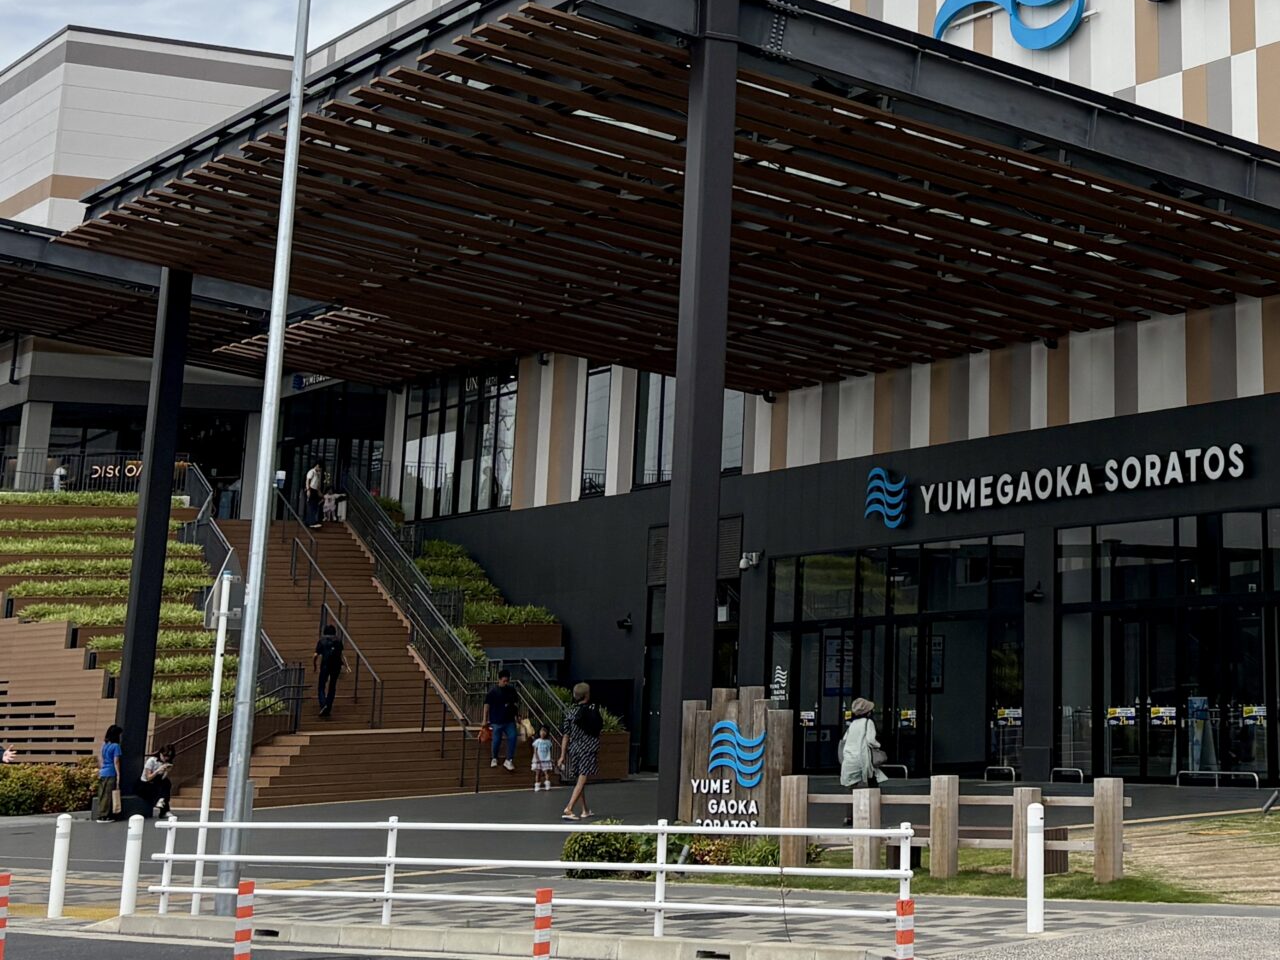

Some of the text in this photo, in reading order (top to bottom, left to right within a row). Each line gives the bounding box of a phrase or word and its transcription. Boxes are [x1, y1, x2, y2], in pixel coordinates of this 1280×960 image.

[920, 442, 1244, 514] YUMEGAOKA SORATOS
[690, 778, 731, 794] YUME
[707, 799, 758, 815] GAOKA
